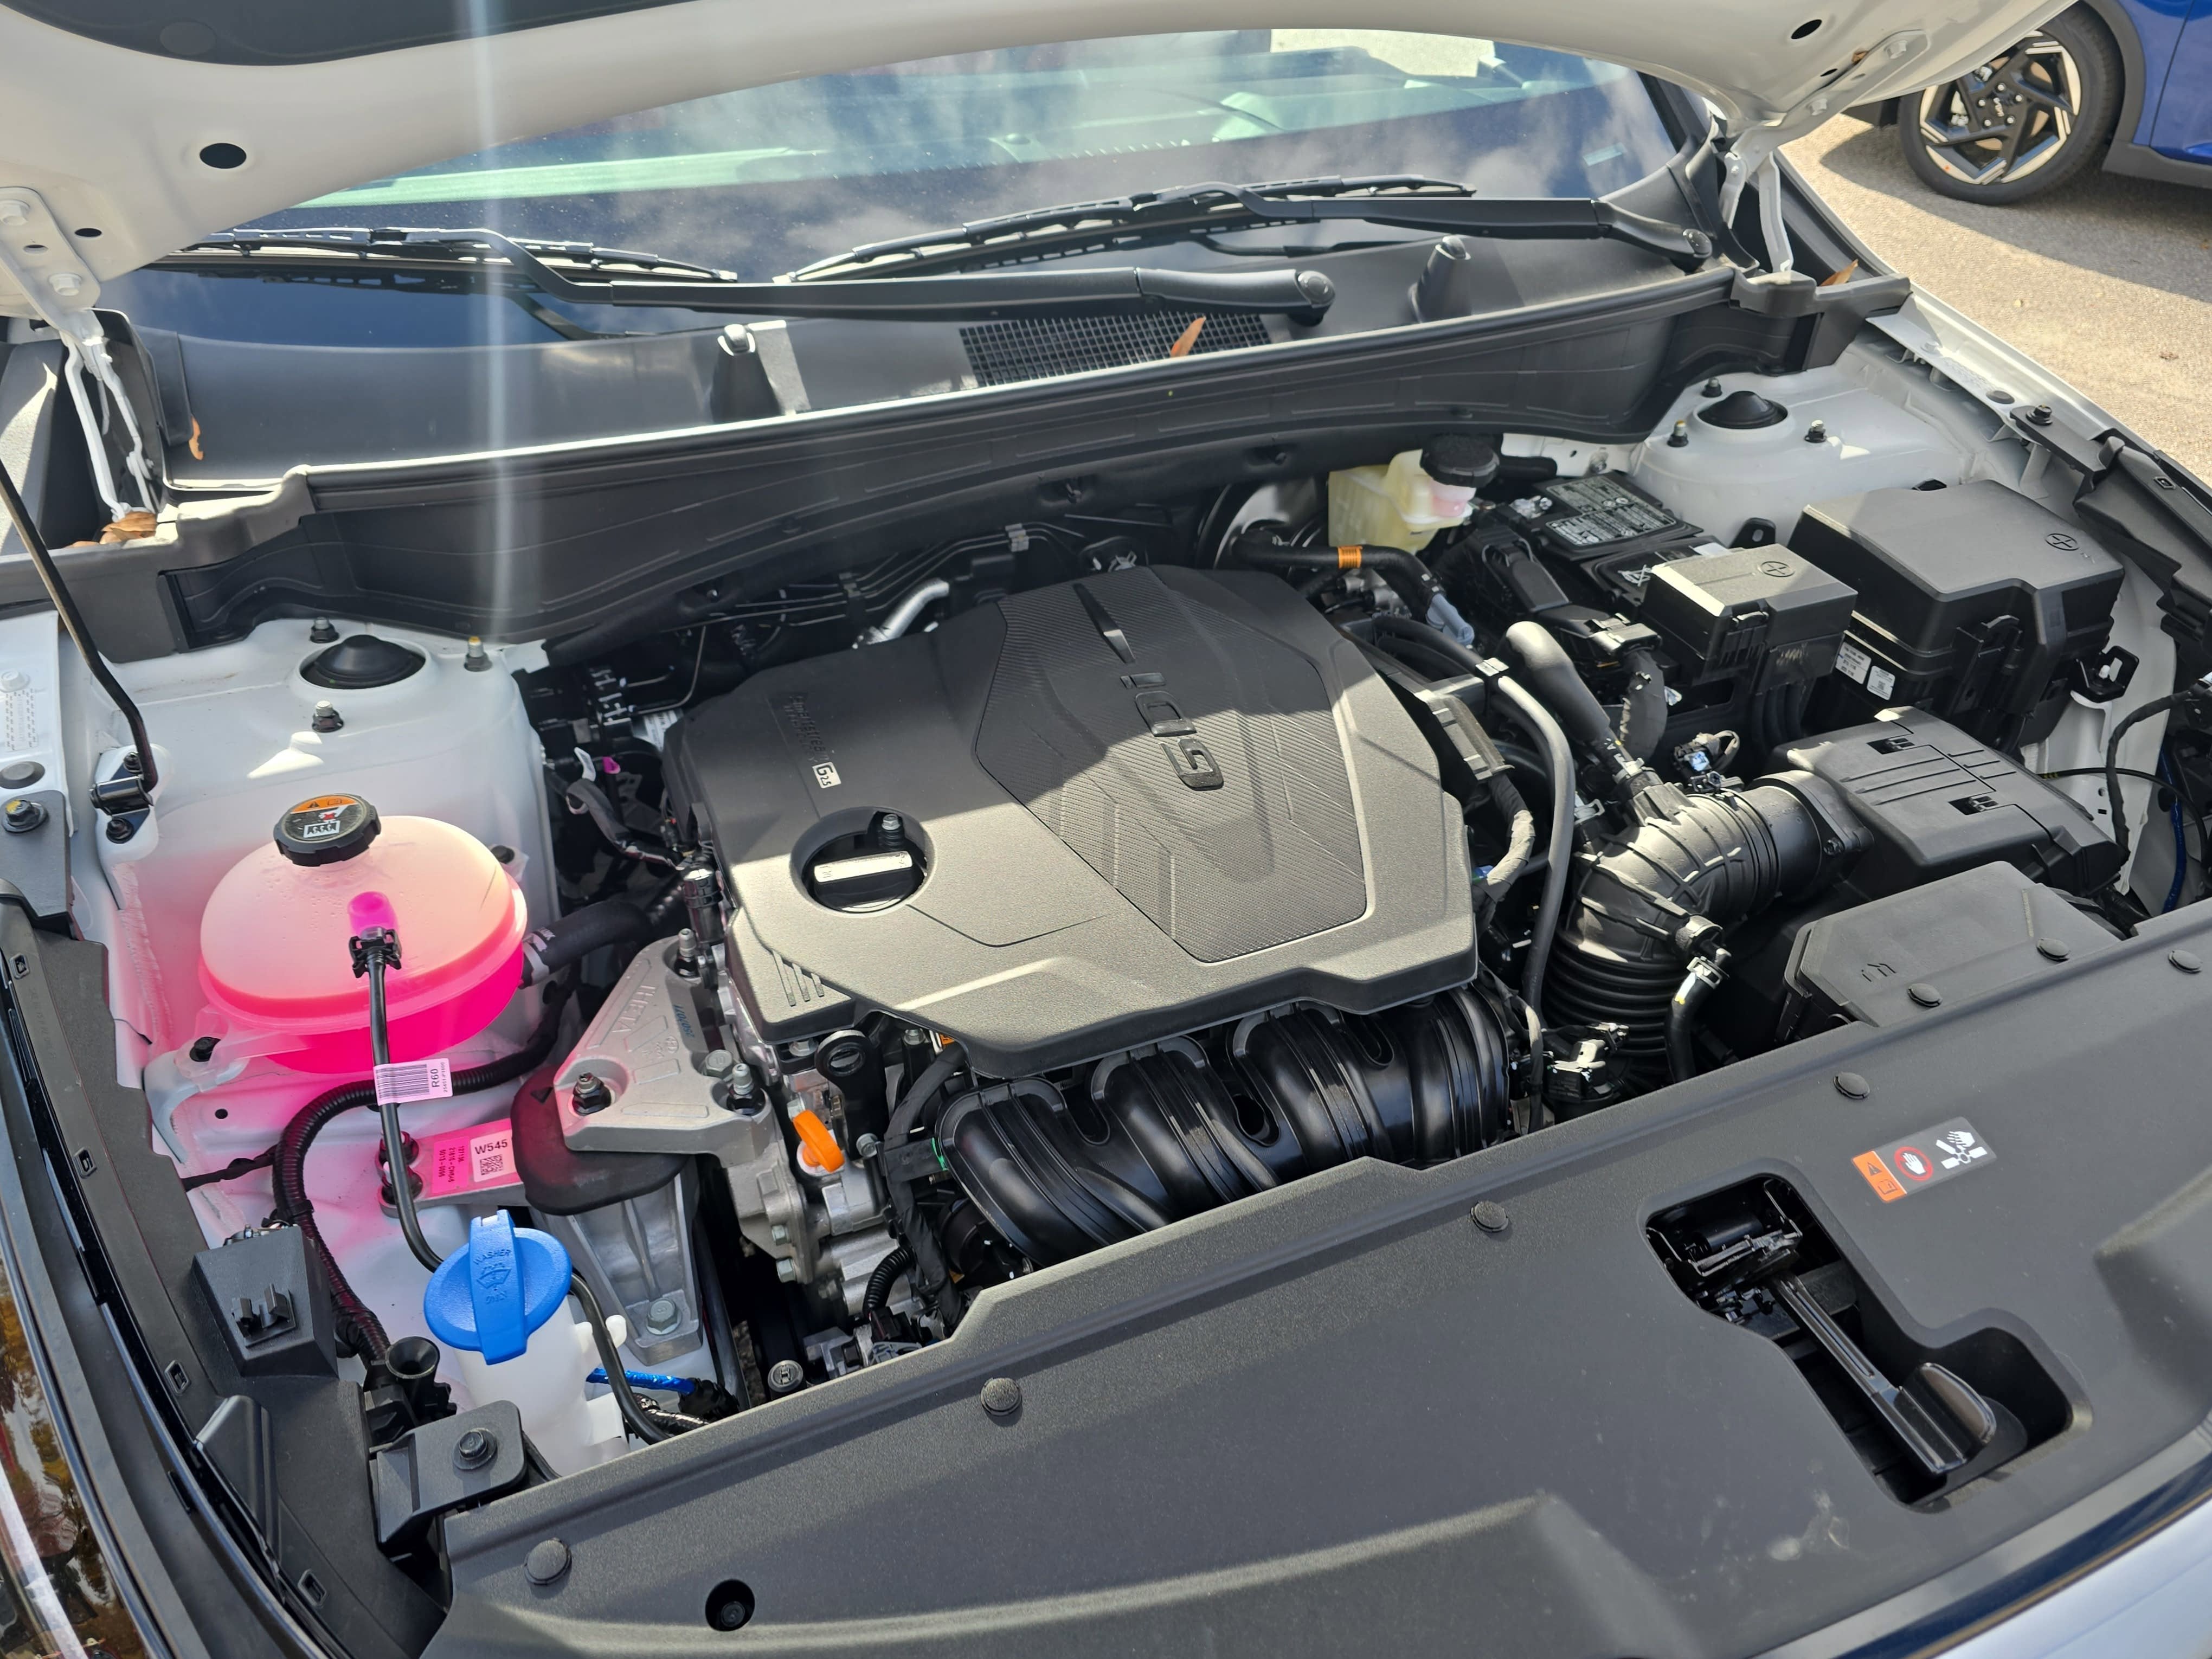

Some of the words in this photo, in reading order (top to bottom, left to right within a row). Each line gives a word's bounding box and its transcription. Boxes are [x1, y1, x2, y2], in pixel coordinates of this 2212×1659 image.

[611, 985, 657, 1033] THETA
[430, 1069, 440, 1088] R60
[474, 1139, 508, 1154] W545
[473, 1249, 511, 1265] WASHER
